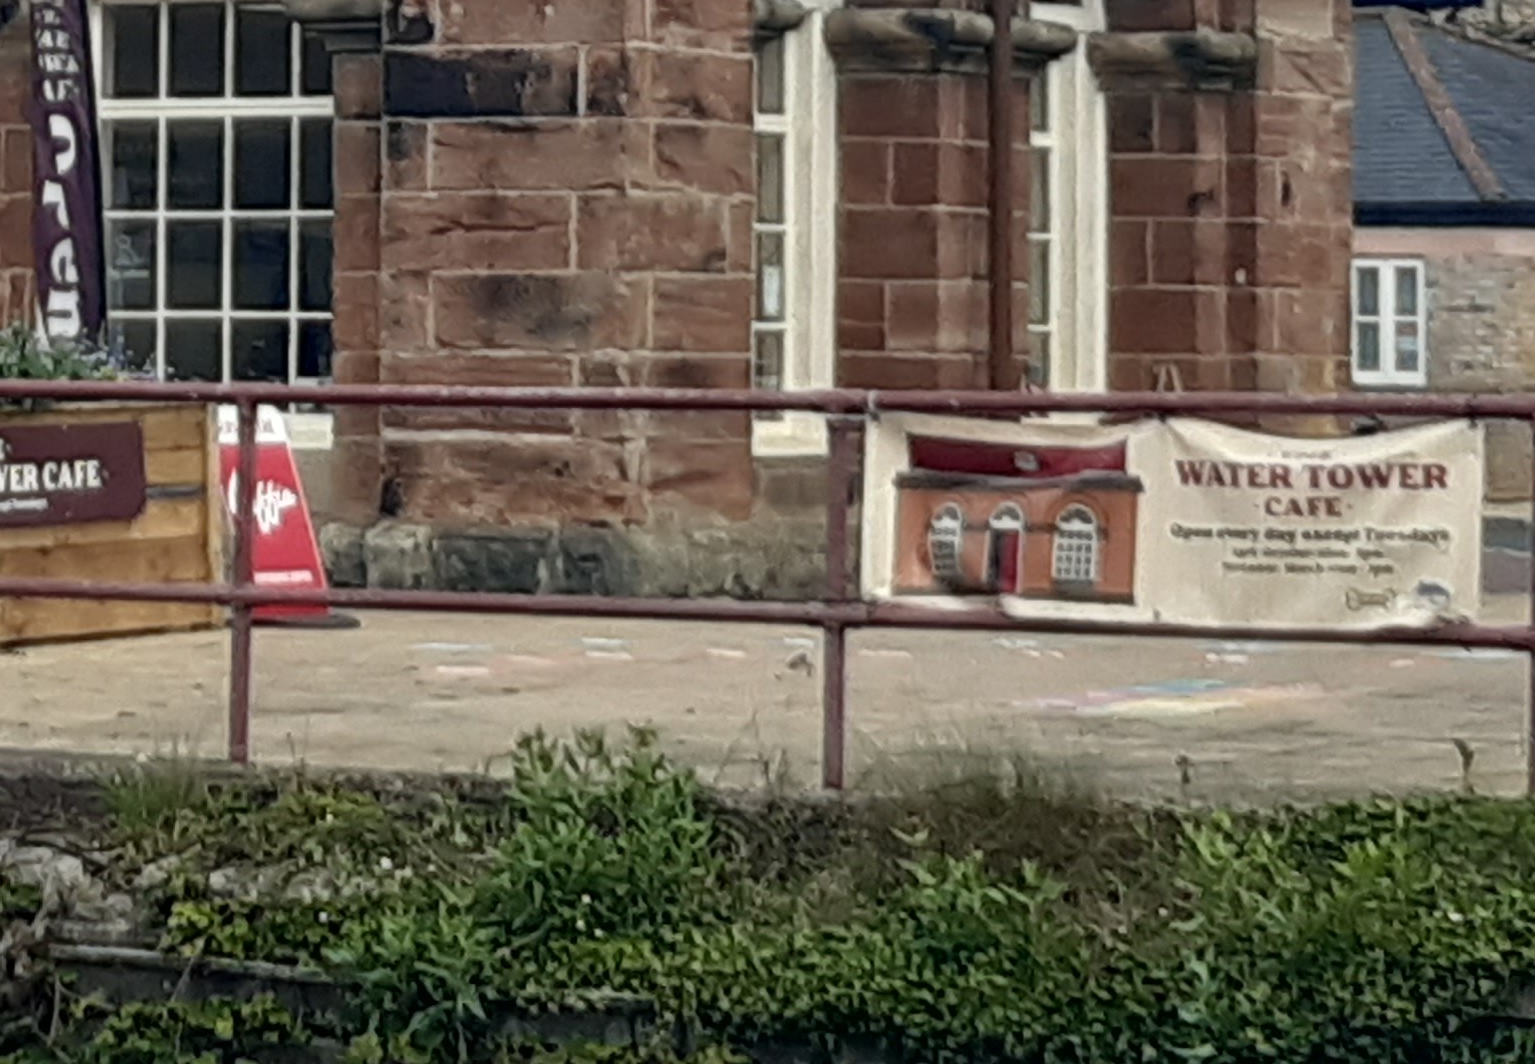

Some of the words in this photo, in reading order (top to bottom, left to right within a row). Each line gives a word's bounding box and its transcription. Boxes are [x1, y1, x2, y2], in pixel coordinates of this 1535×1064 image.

[42, 459, 102, 489] CAFE
[1176, 460, 1293, 489] WATER
[1301, 461, 1448, 490] TOWER
[1264, 495, 1343, 517] CAFE
[1170, 522, 1213, 540] Open
[1216, 526, 1259, 541] every
[1264, 525, 1296, 543] day
[1301, 525, 1359, 543] except
